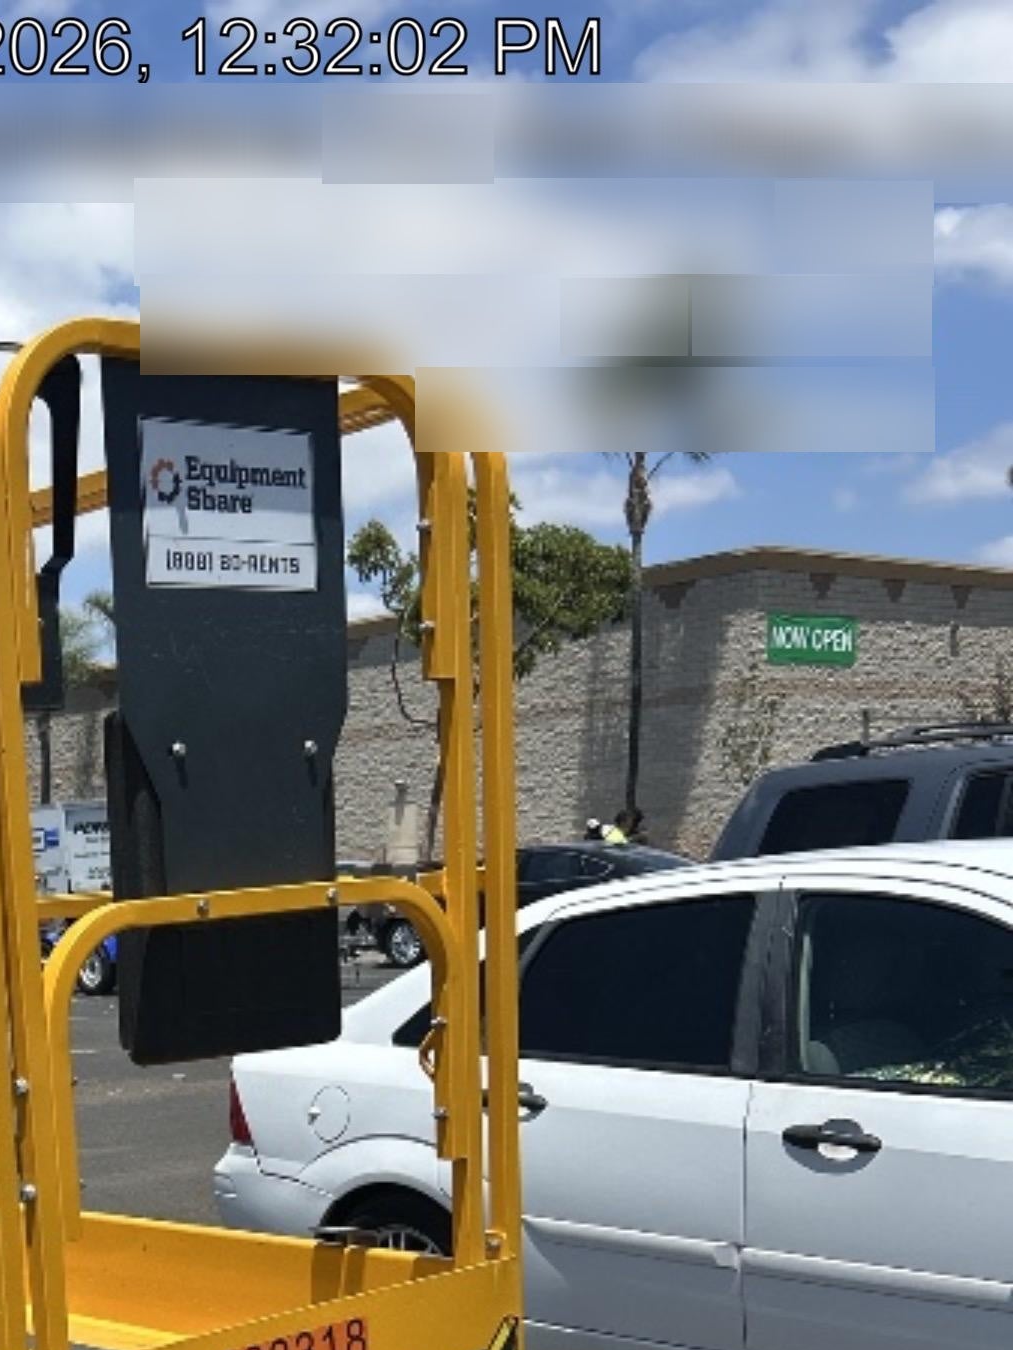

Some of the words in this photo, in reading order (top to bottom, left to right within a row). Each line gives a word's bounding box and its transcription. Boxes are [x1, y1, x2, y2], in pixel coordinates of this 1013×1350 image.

[185, 455, 307, 490] Equipment
[187, 487, 253, 514] Share
[772, 626, 810, 649] NOW
[812, 628, 852, 652] OPEN
